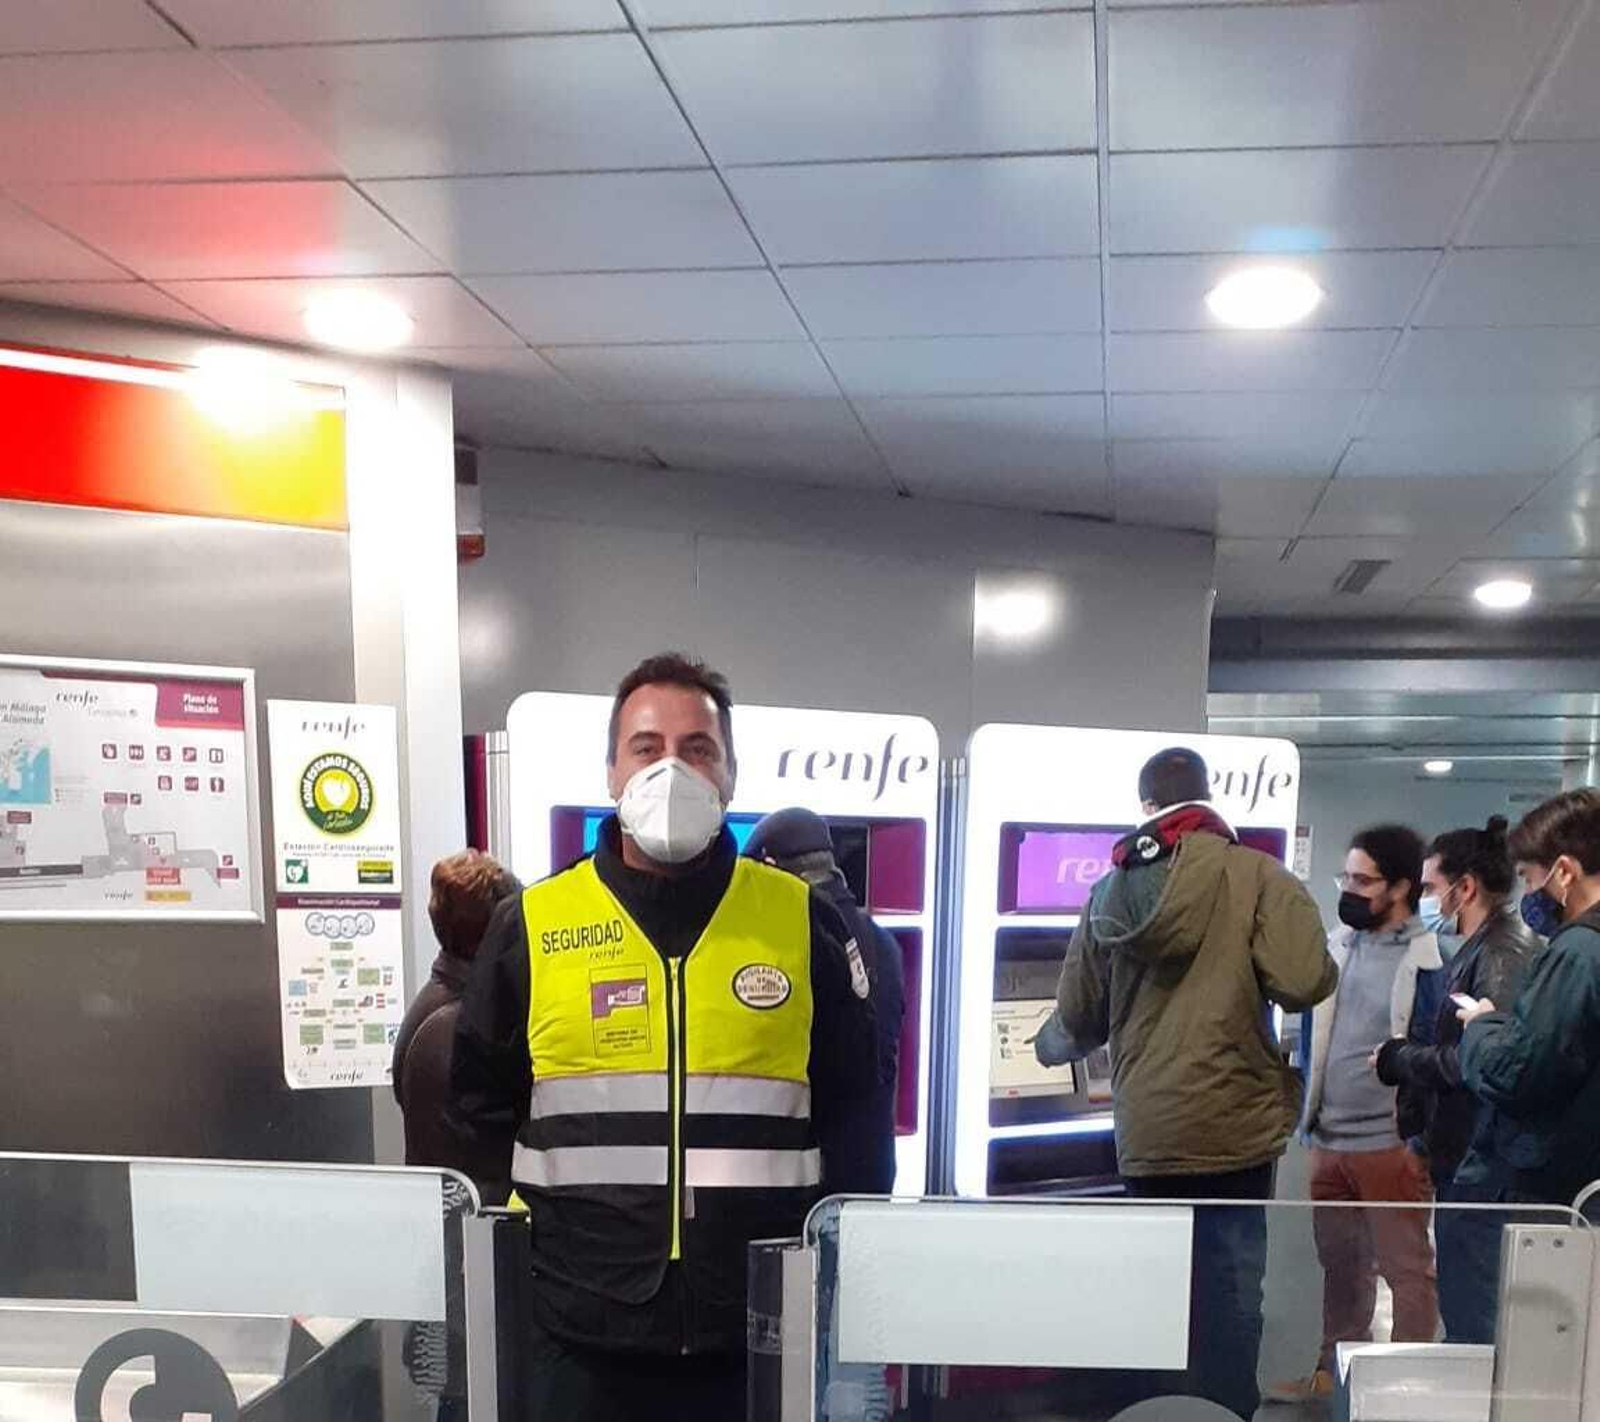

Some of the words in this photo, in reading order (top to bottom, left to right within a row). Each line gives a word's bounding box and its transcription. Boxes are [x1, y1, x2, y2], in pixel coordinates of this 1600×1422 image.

[56, 690, 98, 707] renfe
[302, 716, 365, 740] renfe
[777, 733, 929, 801] renfe
[541, 920, 623, 954] SEGURIDAD
